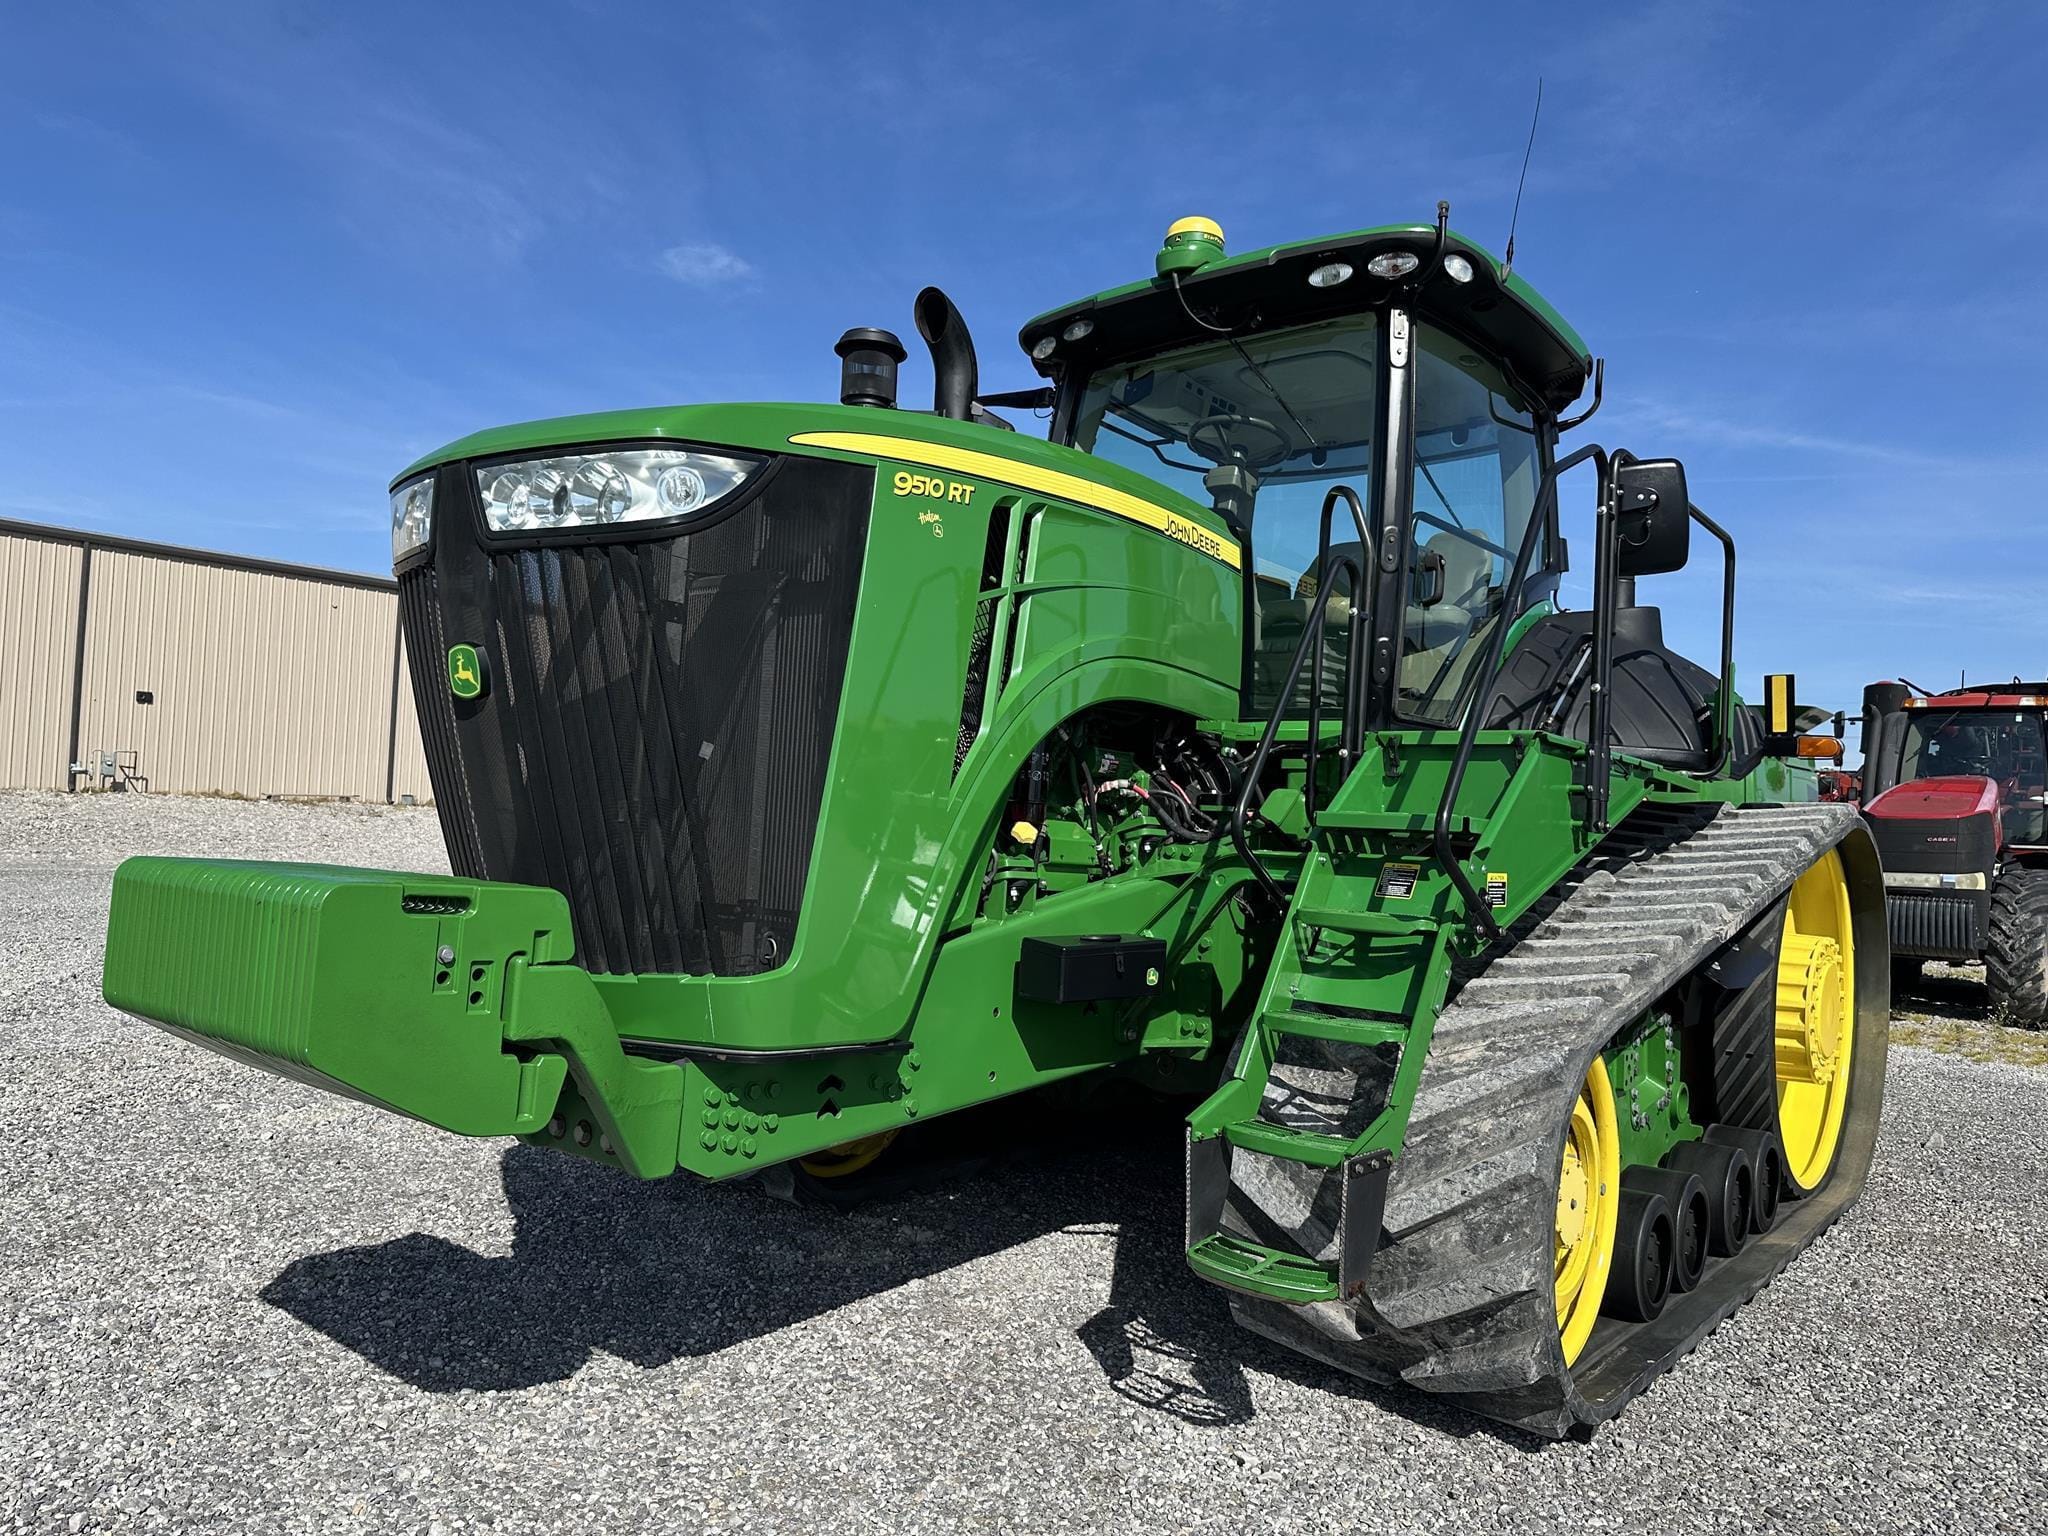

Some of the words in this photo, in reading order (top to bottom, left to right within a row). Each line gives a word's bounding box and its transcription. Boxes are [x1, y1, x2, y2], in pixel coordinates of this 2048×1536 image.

[894, 472, 945, 498] 9510
[948, 482, 975, 505] RT
[1164, 514, 1190, 542] JOHN
[1191, 526, 1221, 558] DEERE
